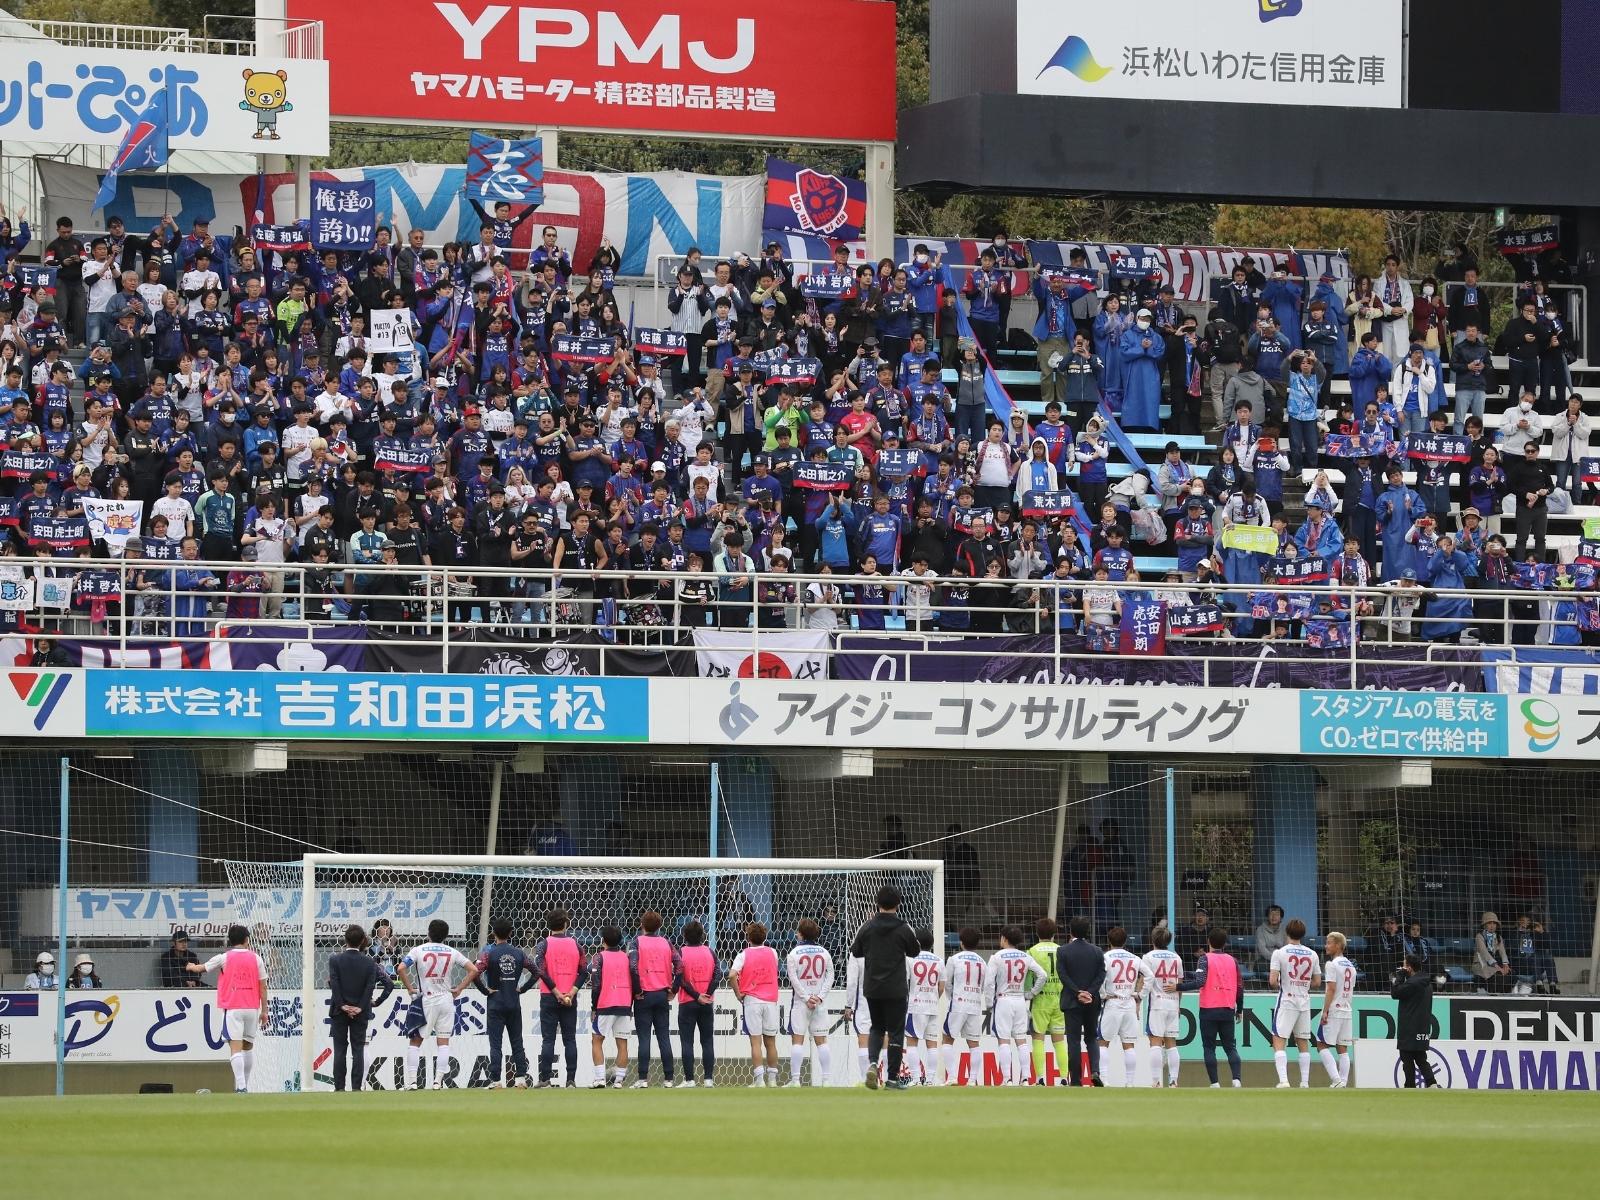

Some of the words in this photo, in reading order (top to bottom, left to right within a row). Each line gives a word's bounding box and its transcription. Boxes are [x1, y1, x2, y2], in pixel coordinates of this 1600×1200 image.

[433, 2, 755, 74] YPMJ
[1122, 46, 1386, 85] 浜松いわた信用金庫
[410, 71, 776, 112] ヤマハモーター精密部品製造
[481, 139, 528, 199] 志
[315, 186, 372, 213] 俺達の
[1116, 256, 1138, 269] 大島
[805, 276, 826, 288] 小林
[558, 340, 582, 353] 藤井
[587, 342, 611, 355] 一志
[641, 331, 662, 344] 佐藤
[880, 450, 901, 464] 井上
[1414, 440, 1437, 453] 小林
[1443, 441, 1466, 454] 岩魚
[1035, 477, 1044, 486] 12
[1034, 495, 1055, 508] 荒木
[1273, 565, 1296, 577] 大島
[1147, 605, 1161, 635] 安田
[1170, 611, 1193, 627] 山本
[1197, 610, 1218, 625] 英臣
[105, 686, 261, 717] 株式会社
[276, 680, 605, 731] 吉和田浜松
[774, 691, 1249, 743] アイジーコンサルティング
[1311, 695, 1497, 722] スタジアムの電気を
[423, 952, 452, 978] 27
[799, 954, 825, 980] 20
[913, 961, 938, 986] 96
[965, 961, 982, 985] 11
[1005, 959, 1025, 984] 13
[1111, 959, 1137, 984] 26
[1154, 960, 1178, 984] 44
[1288, 955, 1312, 981] 32
[1343, 967, 1351, 991] 8
[1415, 1033, 1431, 1042] STA
[1460, 1010, 1600, 1042] DEN
[1457, 1050, 1600, 1089] YAMA
